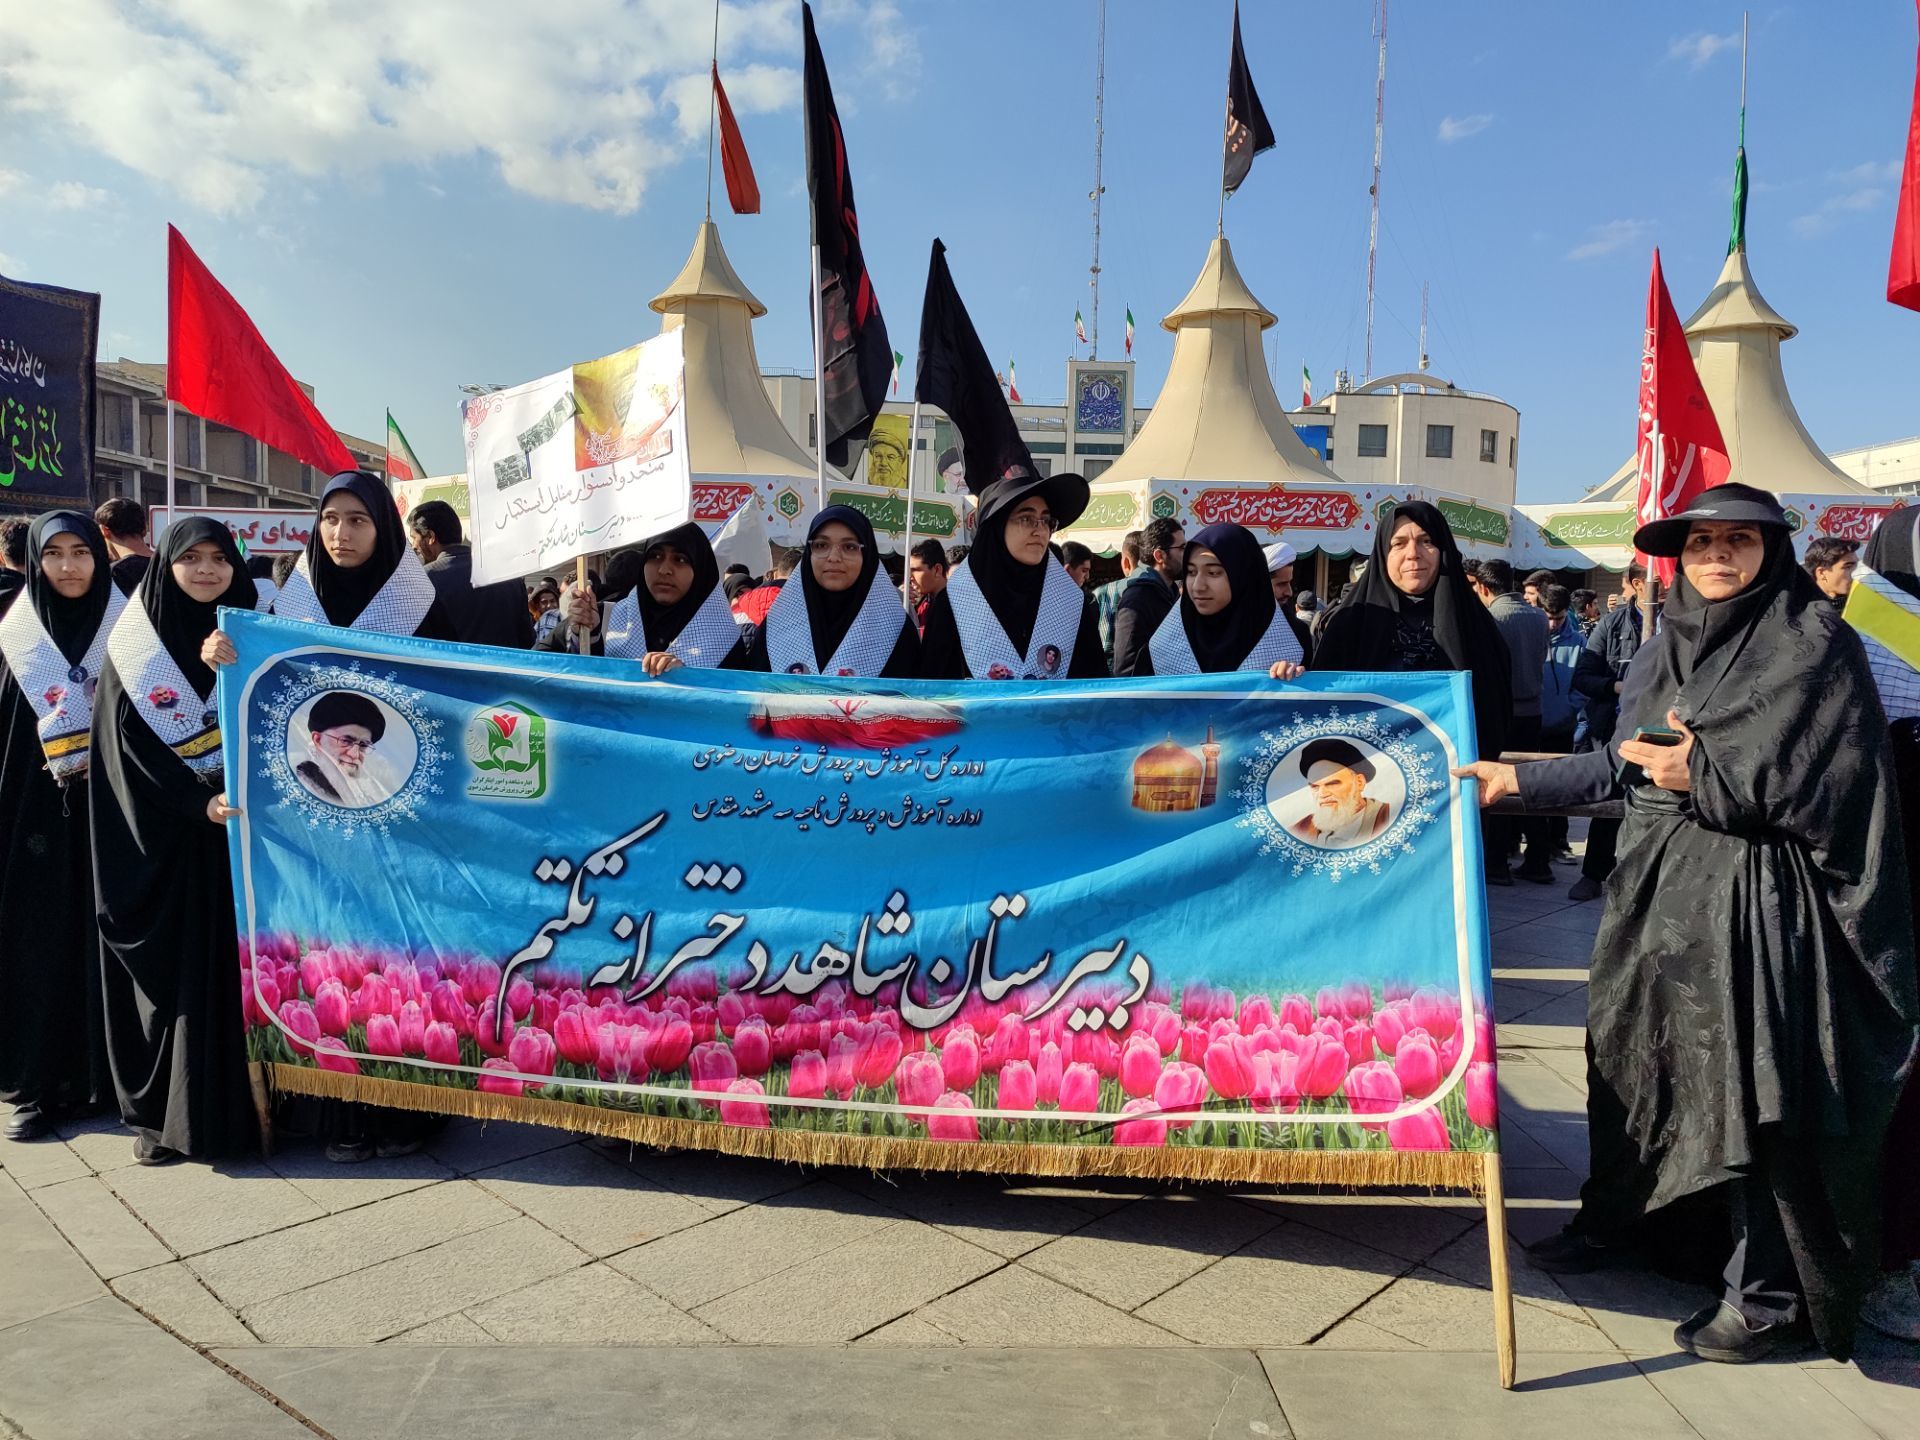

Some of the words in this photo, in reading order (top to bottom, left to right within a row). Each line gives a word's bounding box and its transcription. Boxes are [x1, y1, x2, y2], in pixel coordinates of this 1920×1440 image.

[261, 519, 312, 545] هدای
[693, 743, 744, 768] رضوی
[744, 745, 800, 772] خراسان
[801, 744, 853, 782] پرورش
[856, 759, 864, 770] و
[865, 747, 929, 776] آموزش
[924, 744, 960, 780] کل
[950, 760, 985, 775] اداره
[692, 796, 739, 819] مقدس
[740, 788, 772, 817] مشهد
[773, 808, 792, 818] سه
[794, 796, 825, 830] ناحیه
[823, 792, 876, 832] پرورش
[878, 809, 886, 821] و
[887, 795, 951, 828] آموزش
[947, 808, 982, 825] اداره
[496, 812, 668, 1042] تکتم
[589, 863, 772, 1002] دخترانه
[769, 892, 914, 999] شاهد
[902, 894, 1150, 1031] دبیرستان
